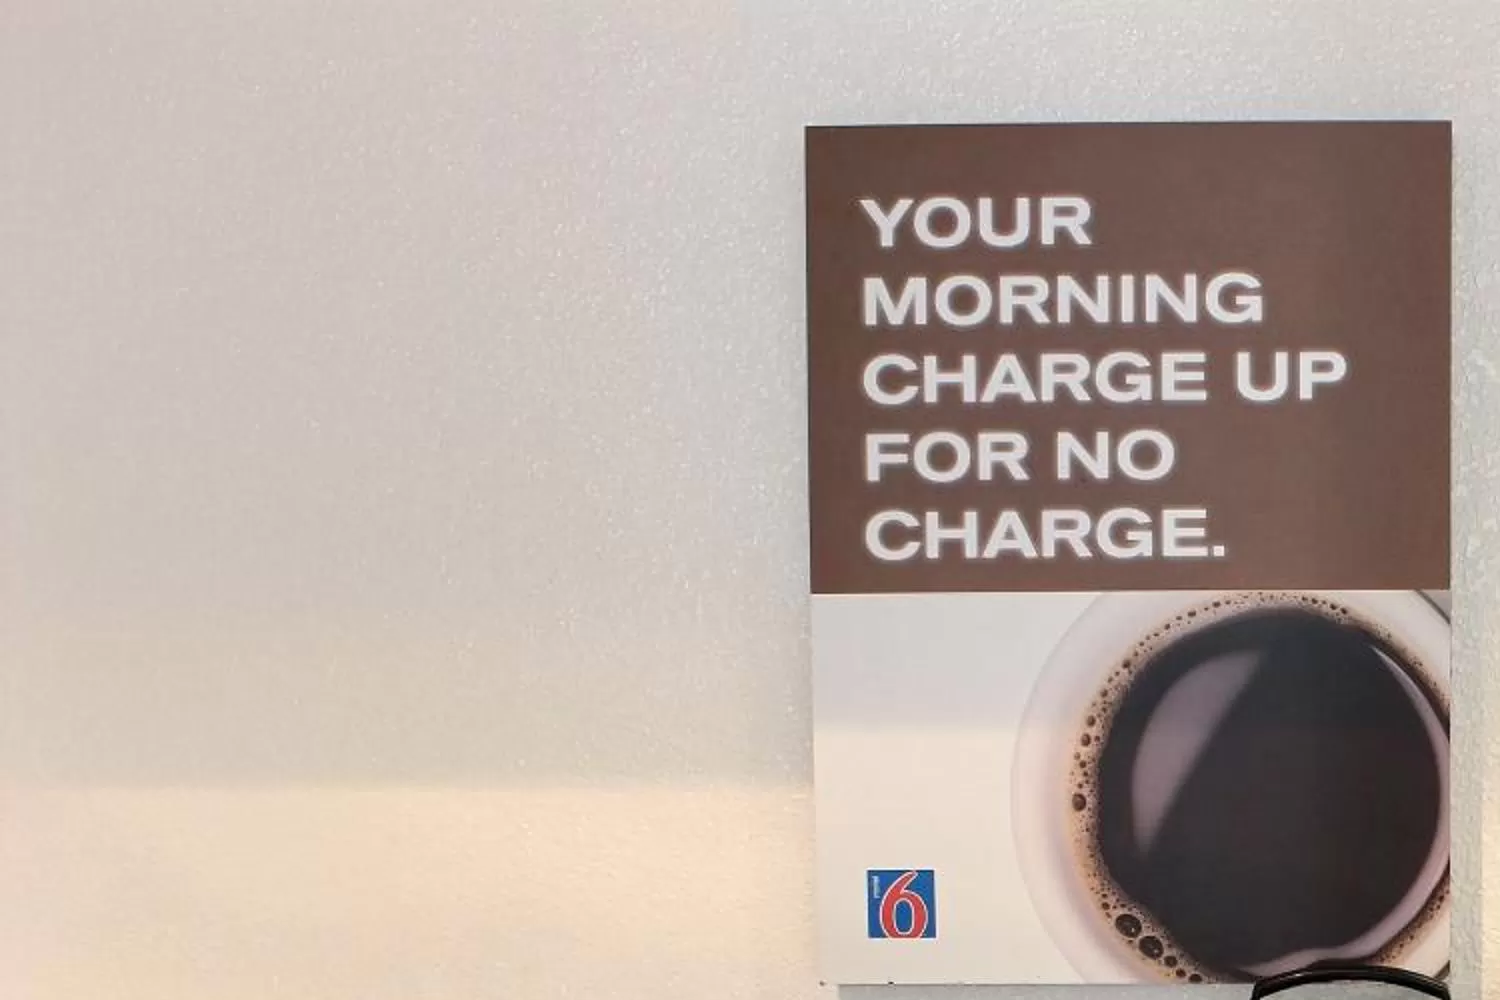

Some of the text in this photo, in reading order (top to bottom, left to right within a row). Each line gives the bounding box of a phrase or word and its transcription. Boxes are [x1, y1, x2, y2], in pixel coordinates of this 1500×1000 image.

[859, 196, 1093, 248] YOUR
[862, 272, 1264, 327] MORNING
[862, 350, 1348, 405] CHARGE UP
[864, 428, 1176, 483] FOR NO
[864, 507, 1226, 561] CHARGE.
[879, 868, 929, 941] 6
